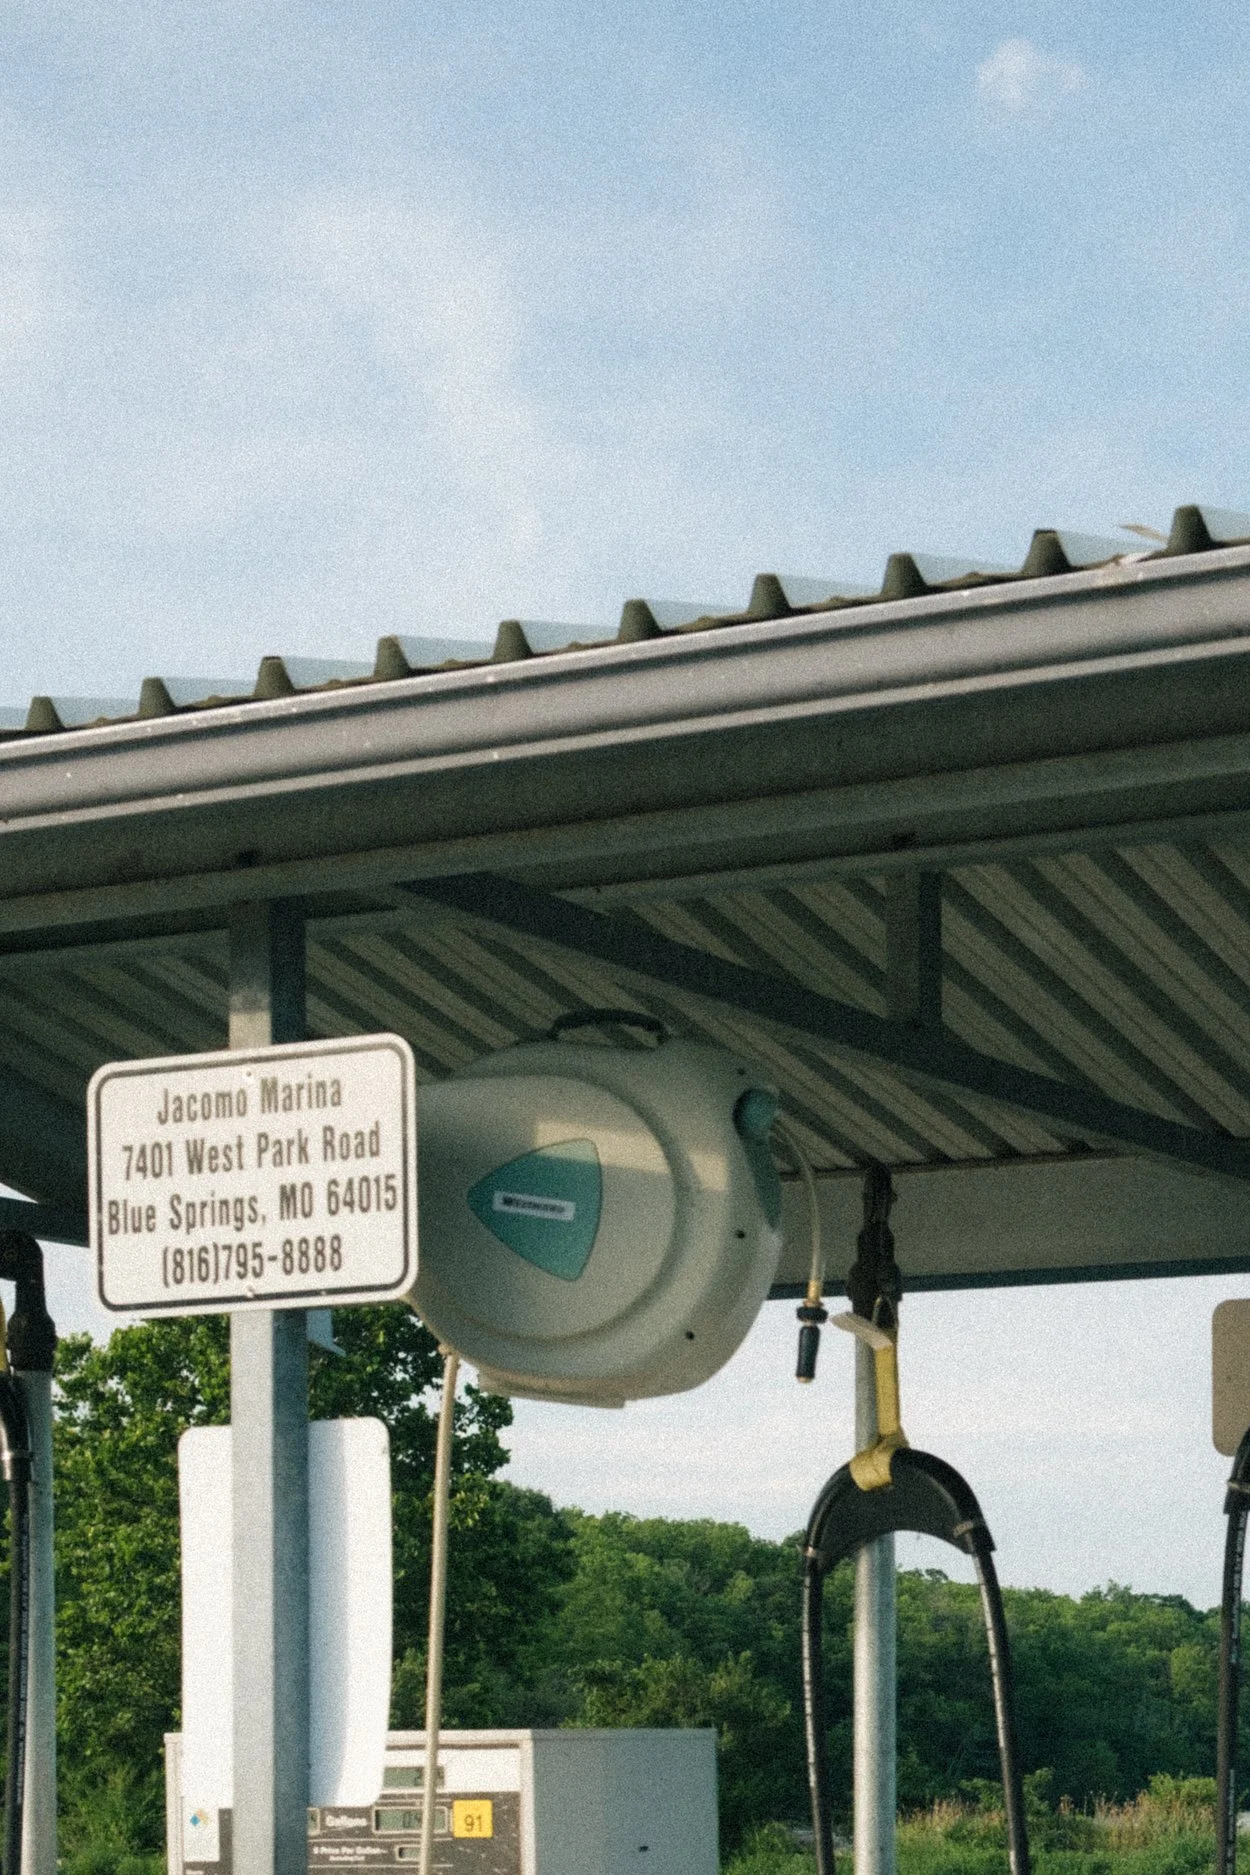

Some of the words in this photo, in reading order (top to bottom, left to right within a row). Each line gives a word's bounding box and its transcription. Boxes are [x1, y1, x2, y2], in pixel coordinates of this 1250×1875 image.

[157, 1086, 248, 1125] Jacomo
[260, 1073, 343, 1114] Marina
[122, 1141, 173, 1181] 7401
[185, 1134, 245, 1175] West
[257, 1128, 310, 1169] Park
[322, 1120, 382, 1162] Road
[107, 1200, 157, 1235] Blue
[169, 1191, 267, 1235] Springs,
[278, 1183, 313, 1221] MO
[327, 1173, 397, 1217] 64015
[162, 1234, 343, 1289] (816)795-8888
[325, 1814, 367, 1828] Gallons
[463, 1814, 482, 1832] 91
